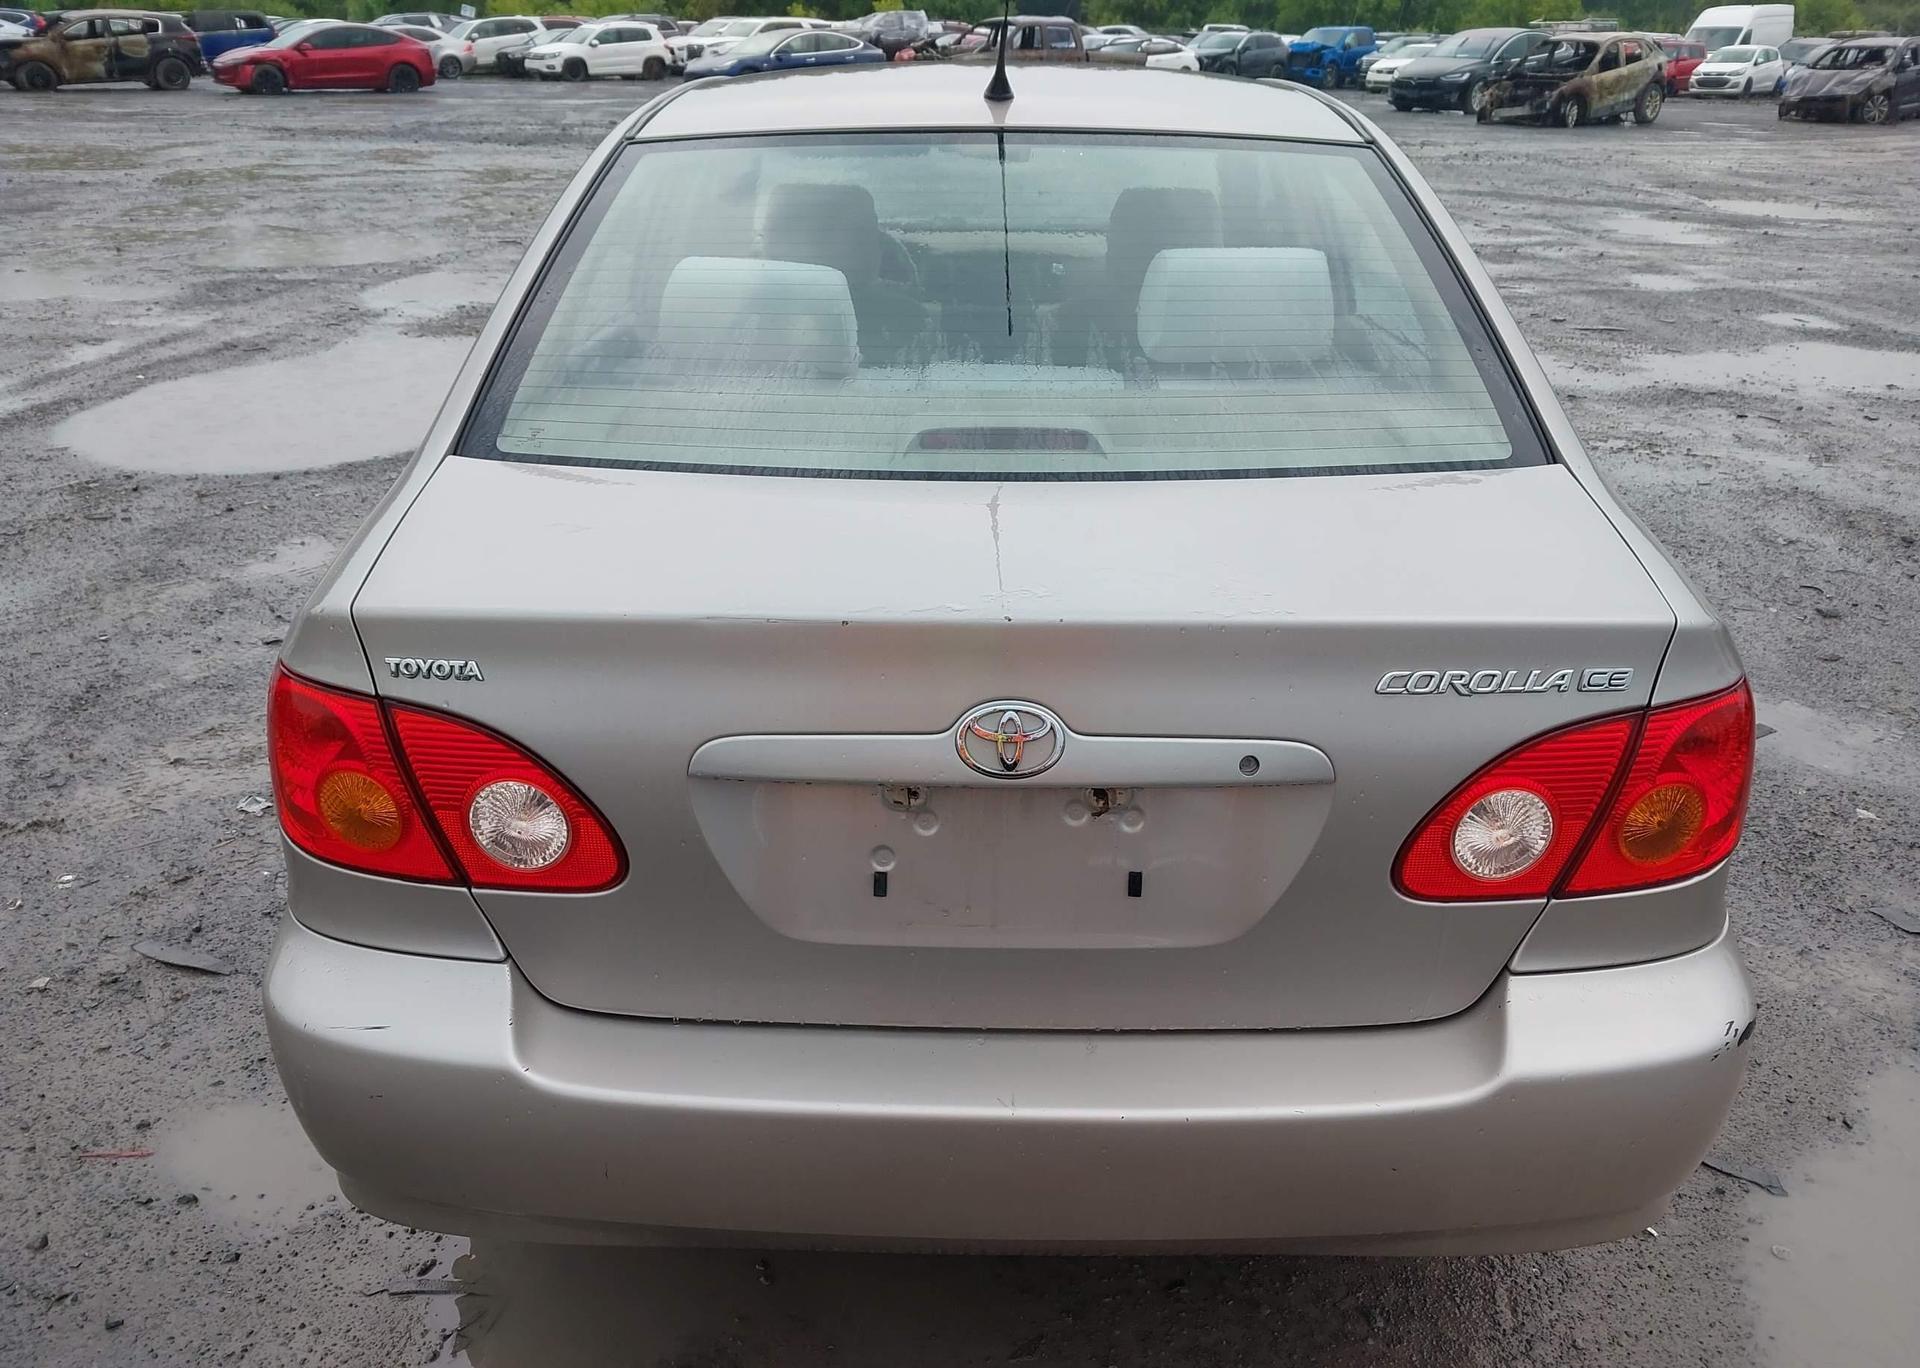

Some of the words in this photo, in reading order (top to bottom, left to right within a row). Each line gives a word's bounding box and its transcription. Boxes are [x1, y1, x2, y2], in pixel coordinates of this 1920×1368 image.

[385, 657, 484, 681] TOYOTA
[1375, 668, 1575, 697] COROLLA
[1581, 669, 1632, 691] CE
